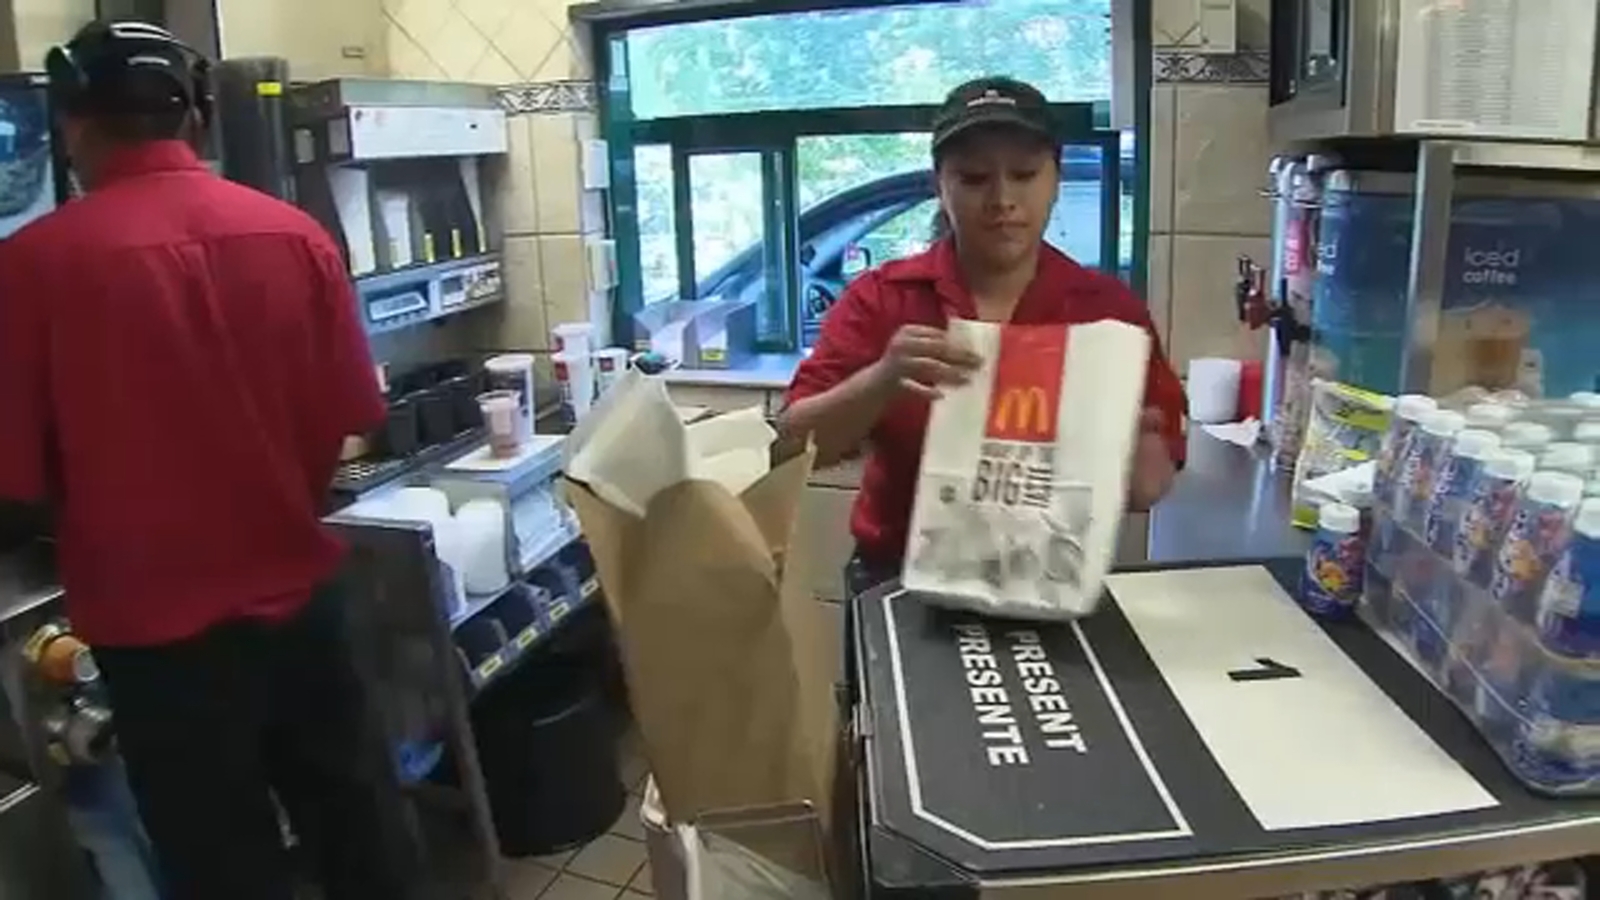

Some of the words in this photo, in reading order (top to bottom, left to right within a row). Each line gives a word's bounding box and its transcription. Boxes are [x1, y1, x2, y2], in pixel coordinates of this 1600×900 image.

[1463, 268, 1517, 285] coffee
[1465, 246, 1521, 267] iced
[952, 622, 1029, 766] PRESENTE
[1006, 629, 1087, 754] PRESENT
